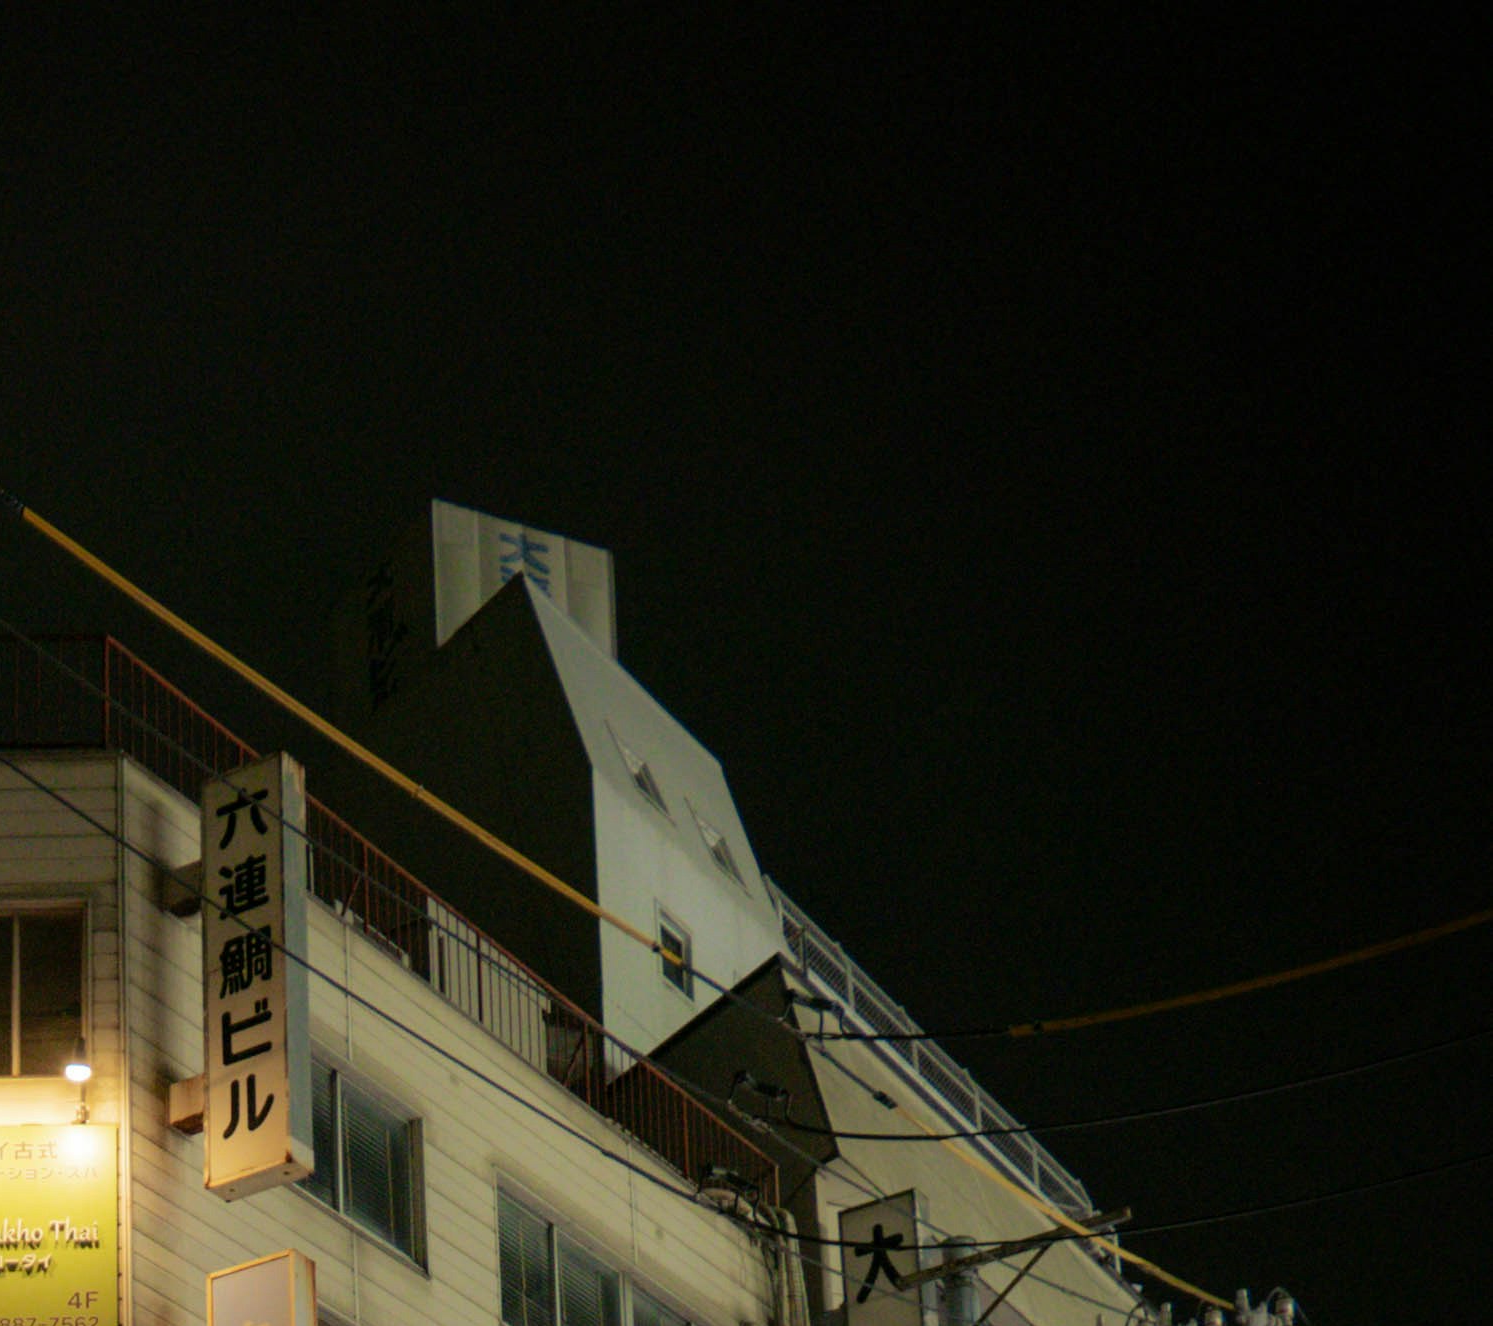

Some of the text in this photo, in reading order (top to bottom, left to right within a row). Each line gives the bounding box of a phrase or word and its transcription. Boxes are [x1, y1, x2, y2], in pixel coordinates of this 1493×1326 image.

[215, 787, 274, 1139] 六連鯛ビル
[49, 1216, 99, 1242] Thai
[67, 1291, 99, 1310] 4F
